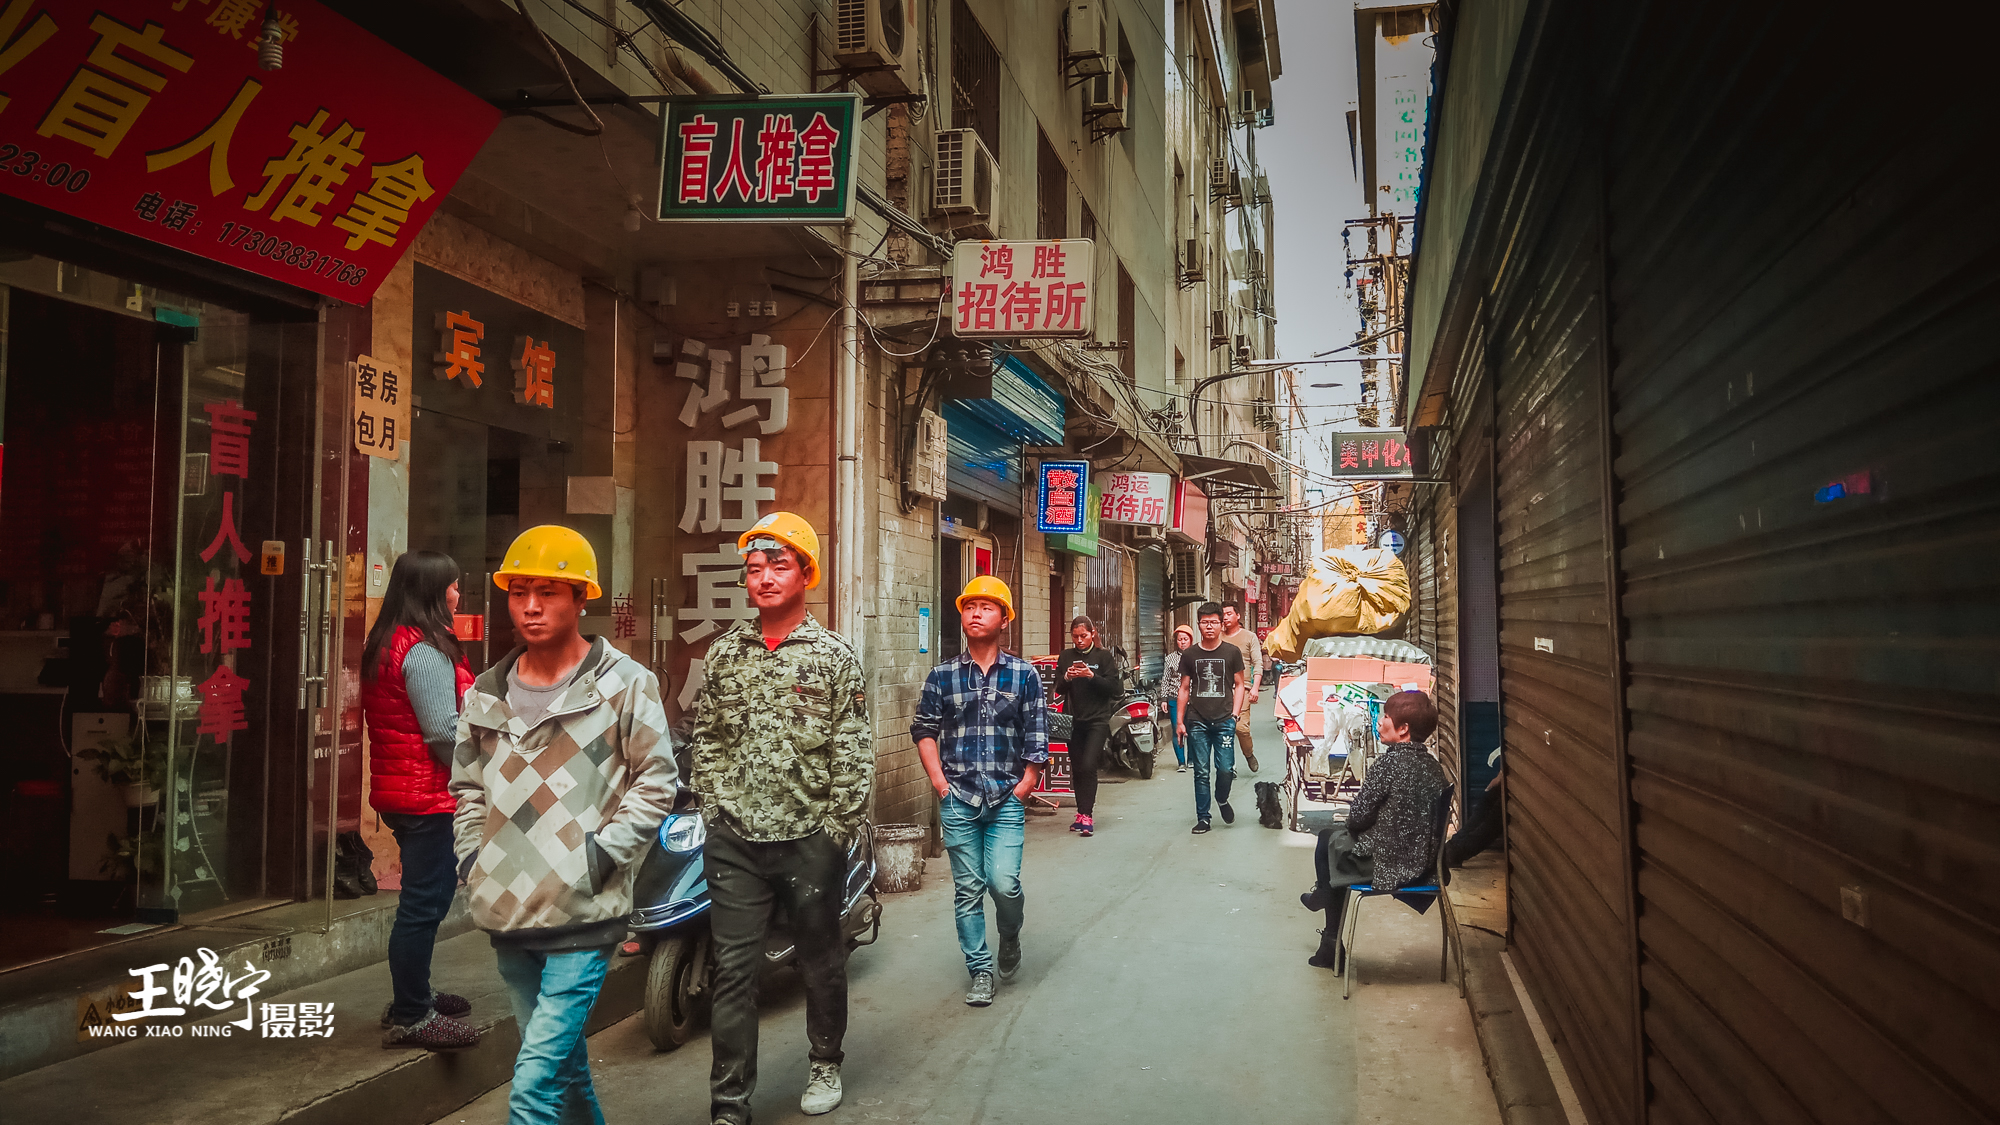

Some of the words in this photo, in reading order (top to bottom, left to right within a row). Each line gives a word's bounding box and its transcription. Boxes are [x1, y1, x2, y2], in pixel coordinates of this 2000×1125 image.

[0, 143, 91, 193] 23:00
[678, 112, 840, 204] 盲人推拿
[217, 221, 368, 286] 17303831768
[980, 244, 1067, 280] 鸿胜
[957, 281, 1087, 330] 招待所
[443, 309, 556, 410] 宾馆
[357, 363, 399, 405] 客房
[356, 410, 397, 452] 包月
[1111, 473, 1151, 494] 鸿运
[1100, 494, 1164, 523] 招待所
[197, 400, 258, 743] 盲人推拿
[1263, 563, 1291, 574] 计生用品
[615, 616, 637, 638] 推
